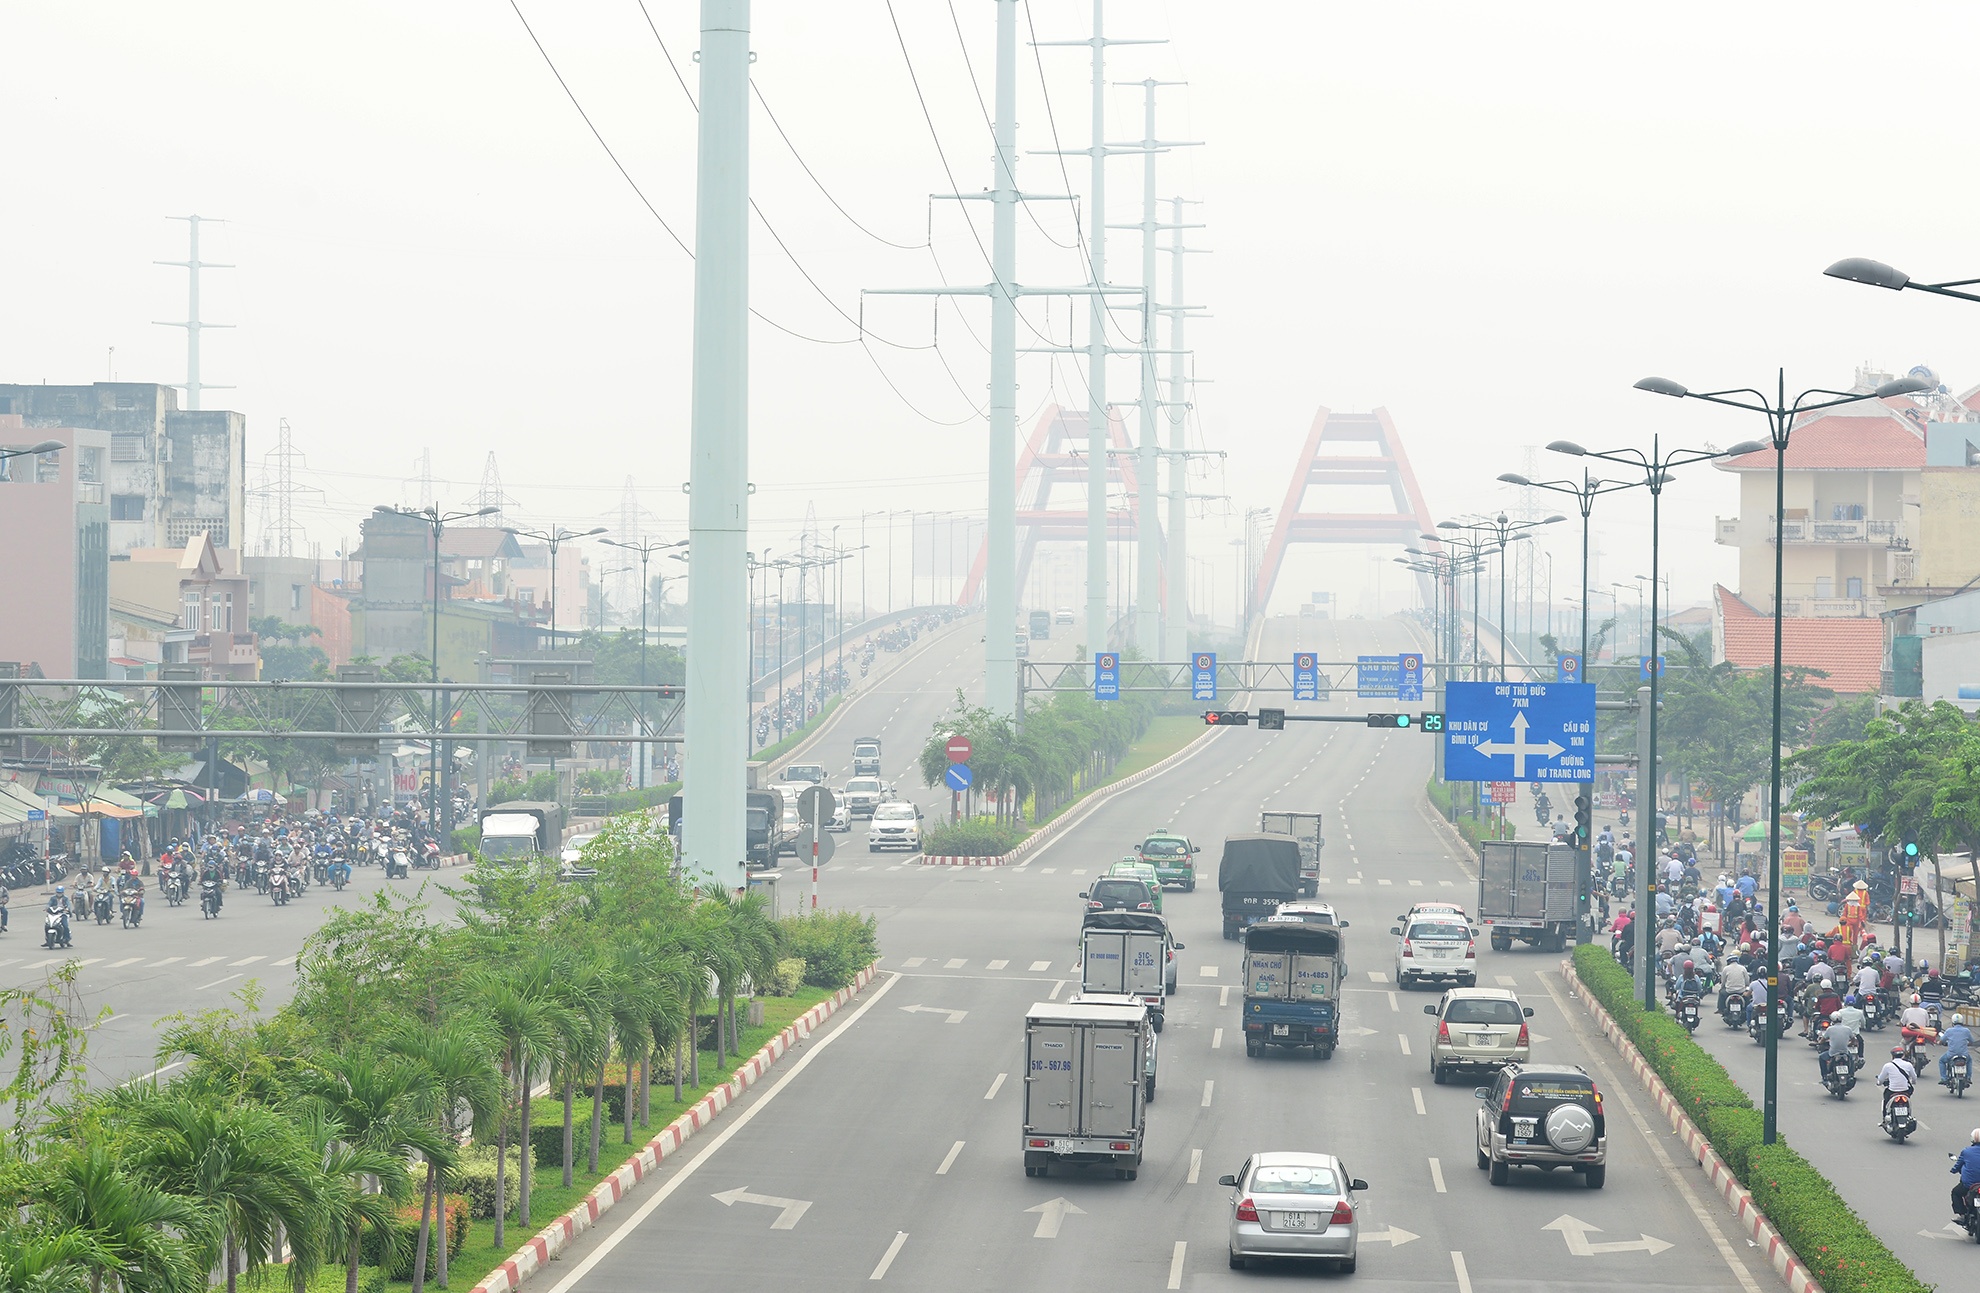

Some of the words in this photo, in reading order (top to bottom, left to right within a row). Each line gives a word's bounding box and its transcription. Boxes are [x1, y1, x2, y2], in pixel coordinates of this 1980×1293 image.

[1103, 657, 1111, 667] 80
[1200, 657, 1208, 667] 80
[1302, 657, 1310, 667] 80
[1406, 660, 1415, 668] 60
[1566, 660, 1574, 670] 60
[1495, 684, 1510, 698] CHỢ
[1512, 683, 1528, 696] THỦ
[1530, 684, 1546, 696] ĐỨC
[1512, 698, 1529, 708] 7KM
[1426, 715, 1442, 730] 25
[1448, 722, 1462, 731] KHU
[1463, 720, 1478, 731] DÂN
[1478, 720, 1488, 732] CƯ
[1452, 732, 1466, 744] BÌNH
[1468, 734, 1479, 746] LỢI
[1570, 736, 1584, 746] 1KM
[1560, 754, 1584, 766] ĐƯỜNG
[1537, 767, 1547, 778] NƠ
[1549, 768, 1572, 778] TRANG
[1572, 769, 1591, 778] LONG
[394, 768, 416, 791] PHỞ
[1032, 1060, 1042, 1070] 51C
